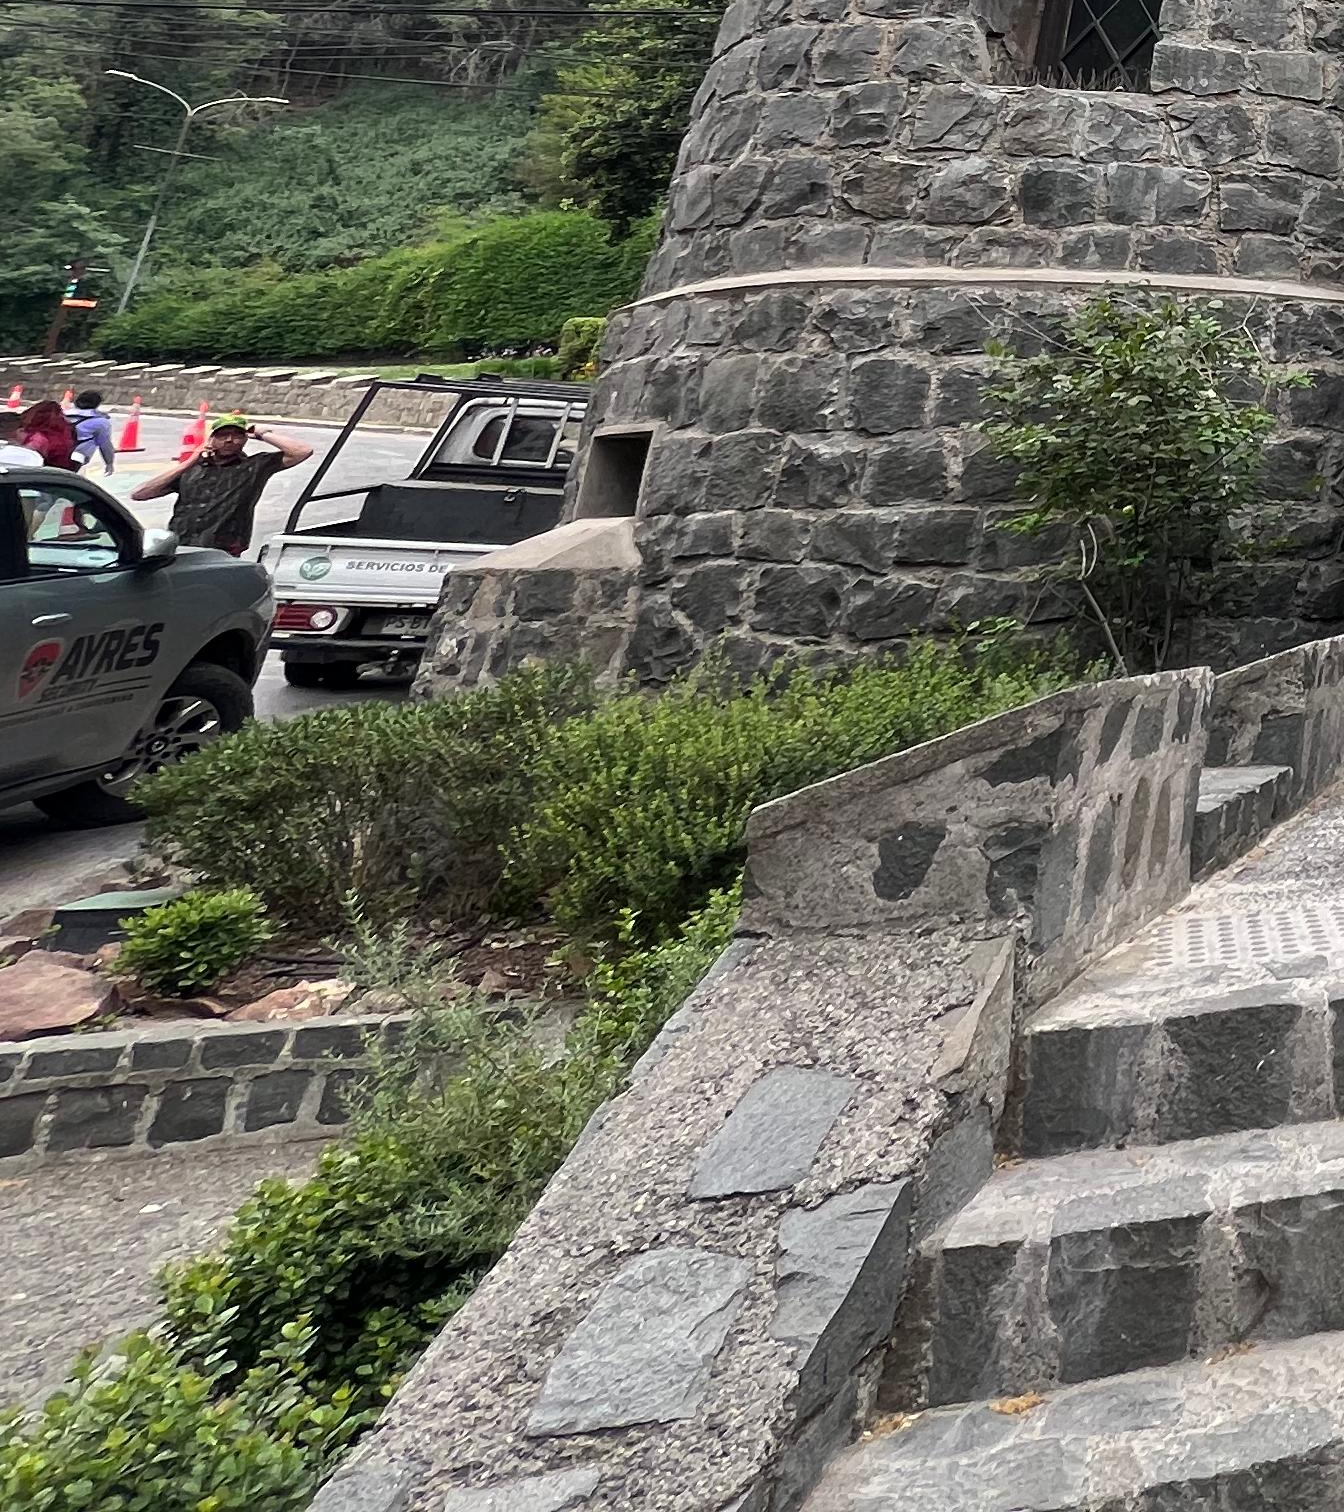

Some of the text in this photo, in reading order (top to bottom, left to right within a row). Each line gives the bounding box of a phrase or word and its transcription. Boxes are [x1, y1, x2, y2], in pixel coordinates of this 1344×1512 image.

[345, 560, 448, 574] SERVICIOS DE
[50, 622, 165, 685] AYRES
